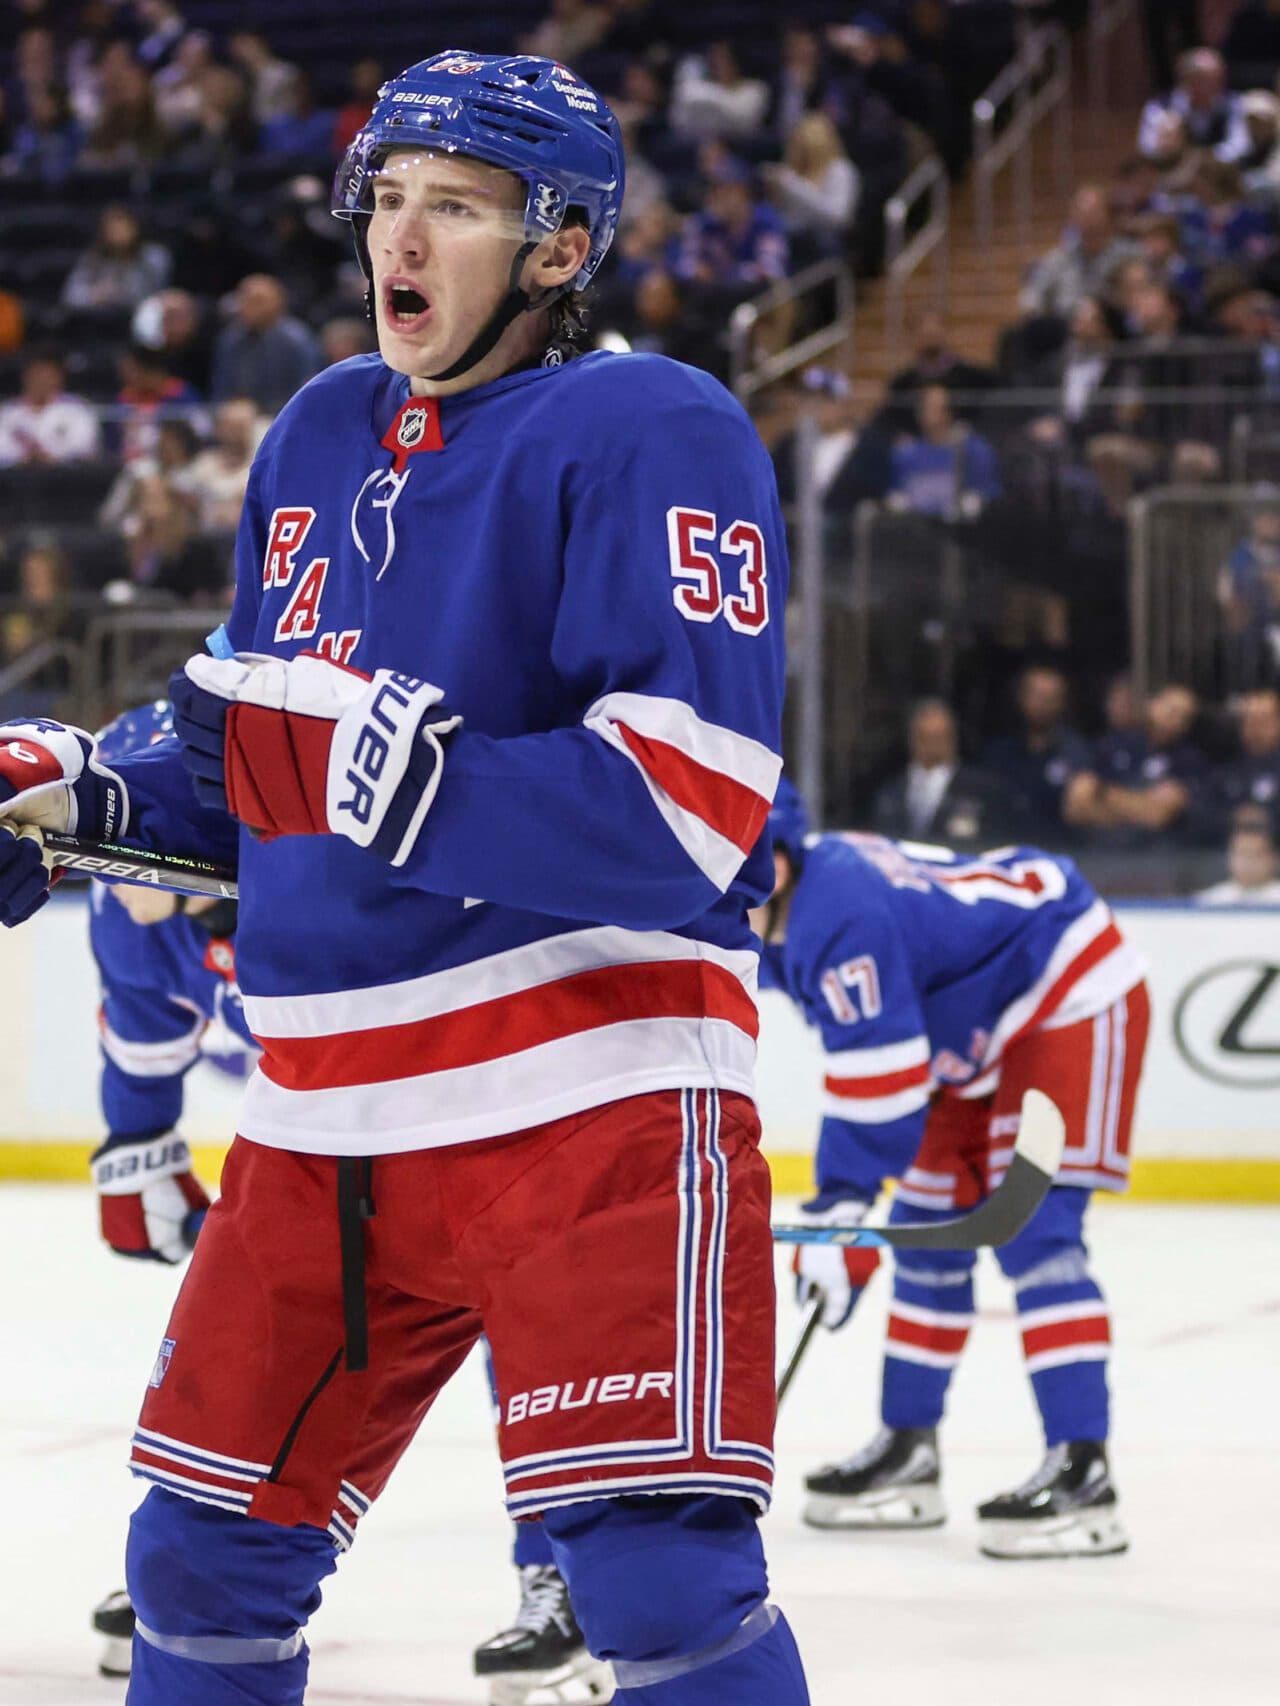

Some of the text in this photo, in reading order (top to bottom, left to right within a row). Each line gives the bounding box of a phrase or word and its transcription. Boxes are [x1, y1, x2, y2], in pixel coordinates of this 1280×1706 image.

[391, 92, 453, 107] BAUER
[565, 94, 598, 113] Moore
[666, 506, 769, 637] 53
[337, 671, 425, 825] AUER
[97, 843, 163, 862] TECHNOLOGY
[165, 855, 196, 868] TAPER
[820, 954, 883, 1026] 17
[505, 1371, 674, 1426] BAUER
